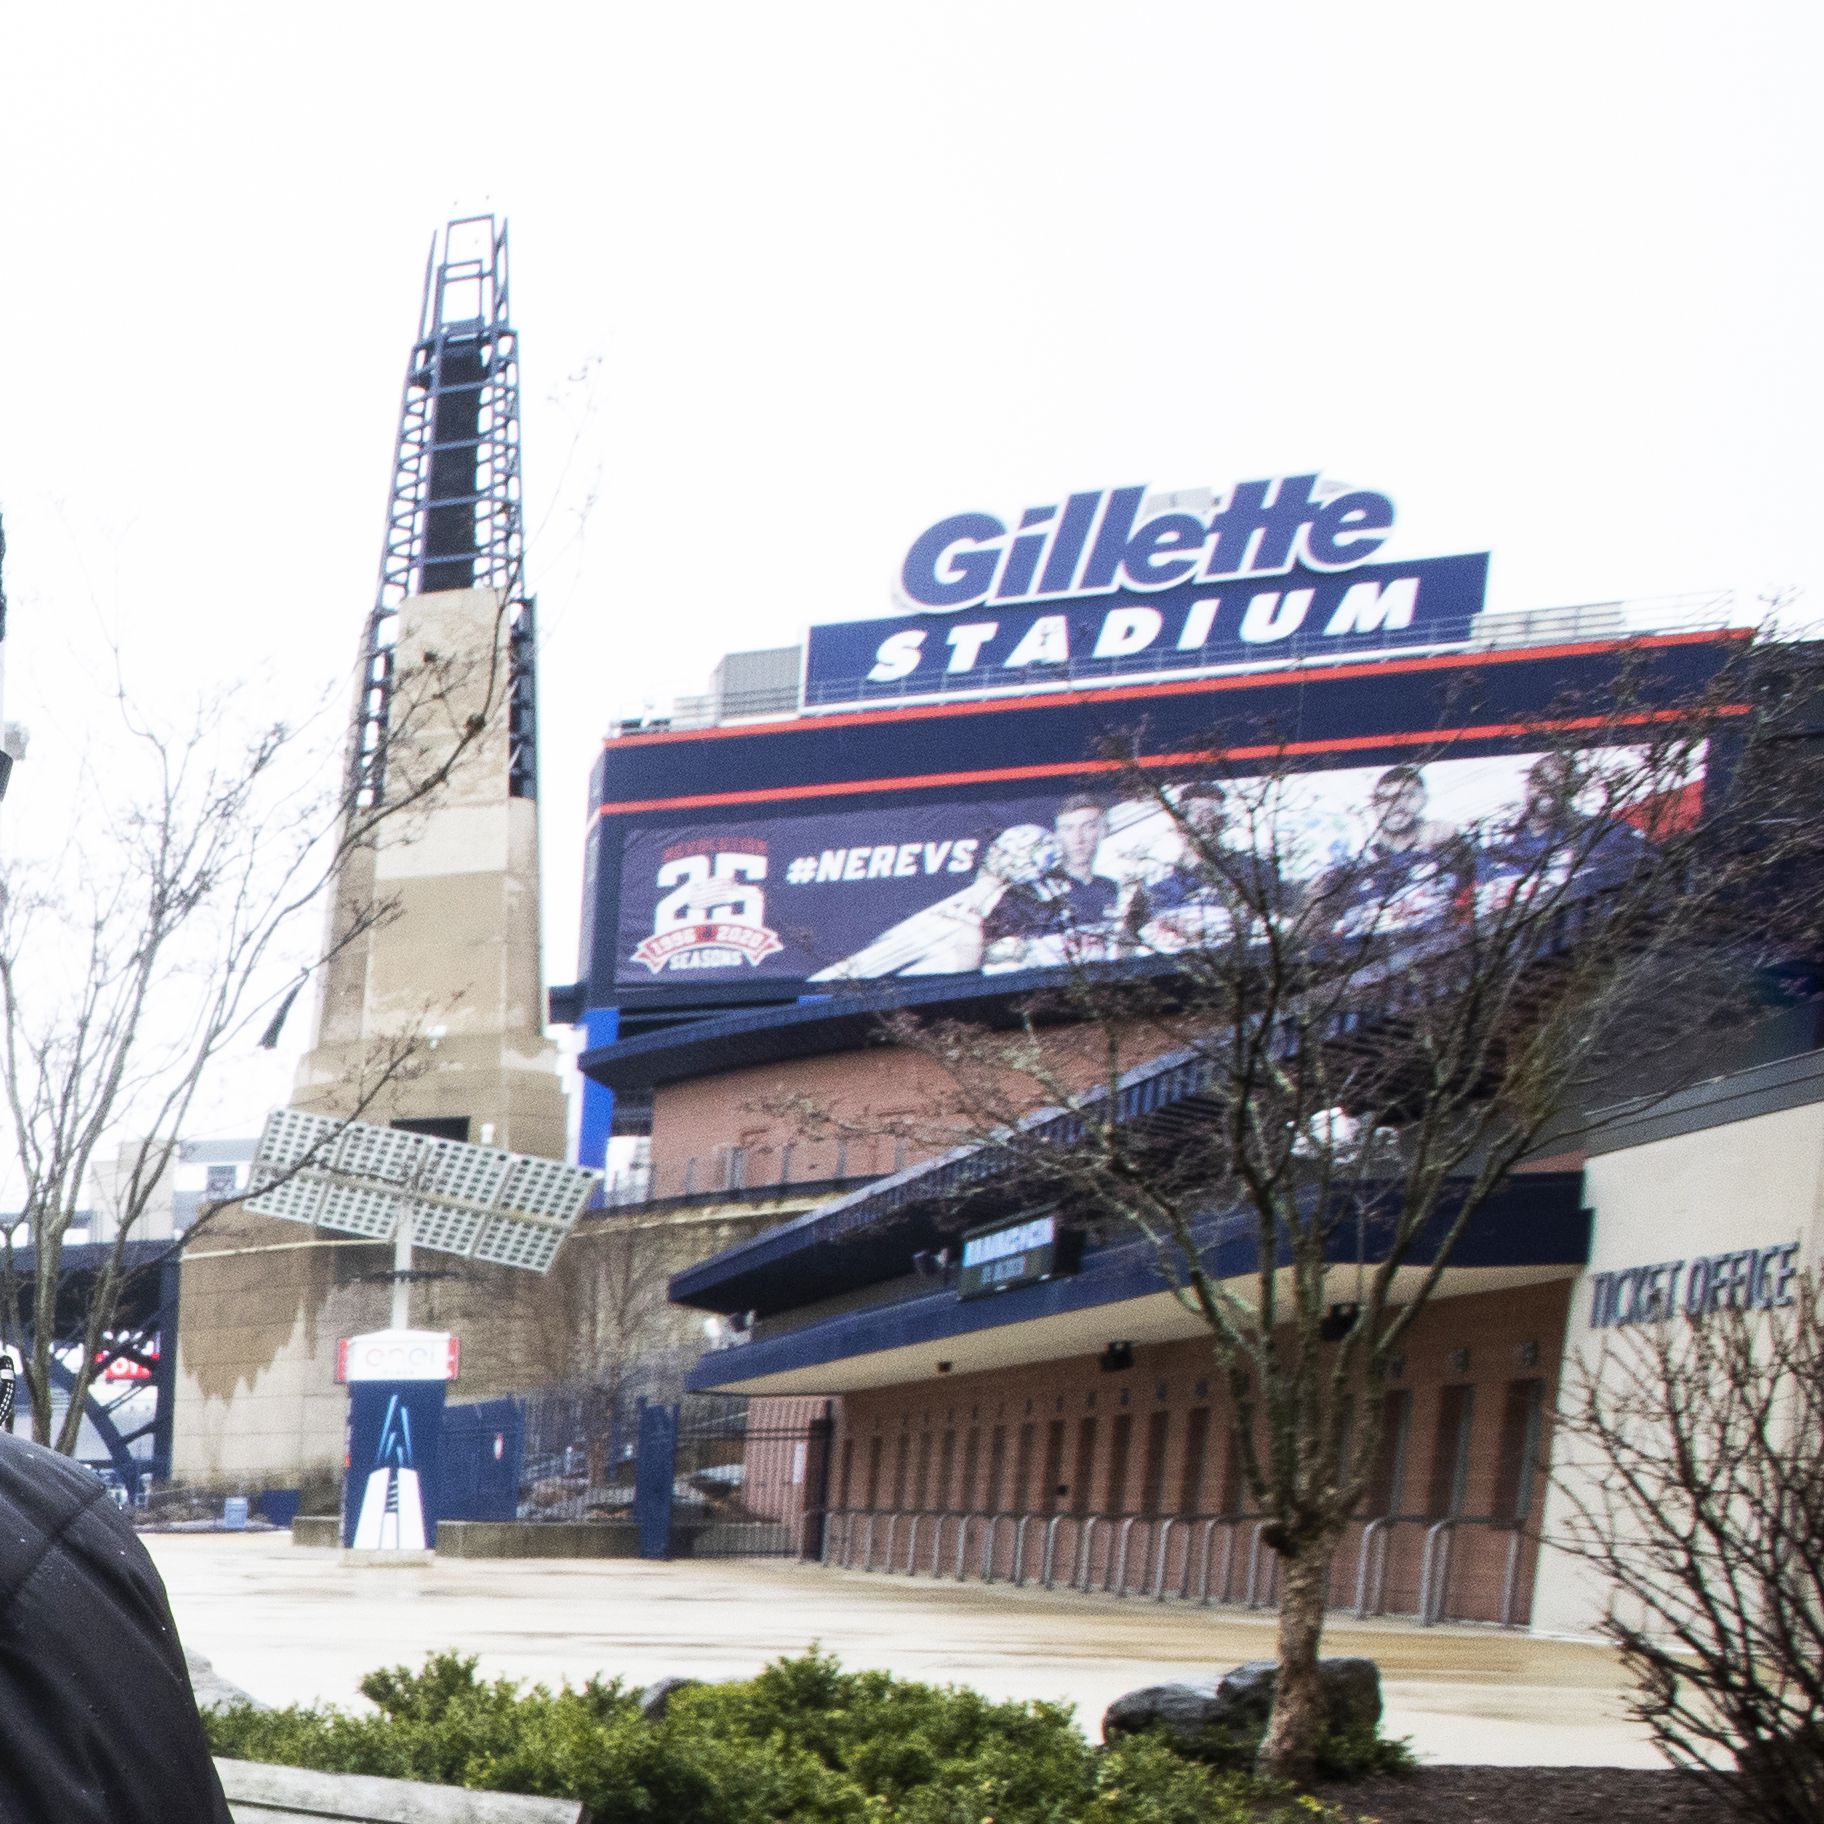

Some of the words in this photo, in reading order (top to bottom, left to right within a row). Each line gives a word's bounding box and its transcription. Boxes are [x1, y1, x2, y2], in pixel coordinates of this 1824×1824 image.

[897, 470, 1398, 614] Gillette
[866, 578, 1419, 682] STADIUM
[654, 852, 768, 932] 25
[785, 838, 982, 886] #NEREVS
